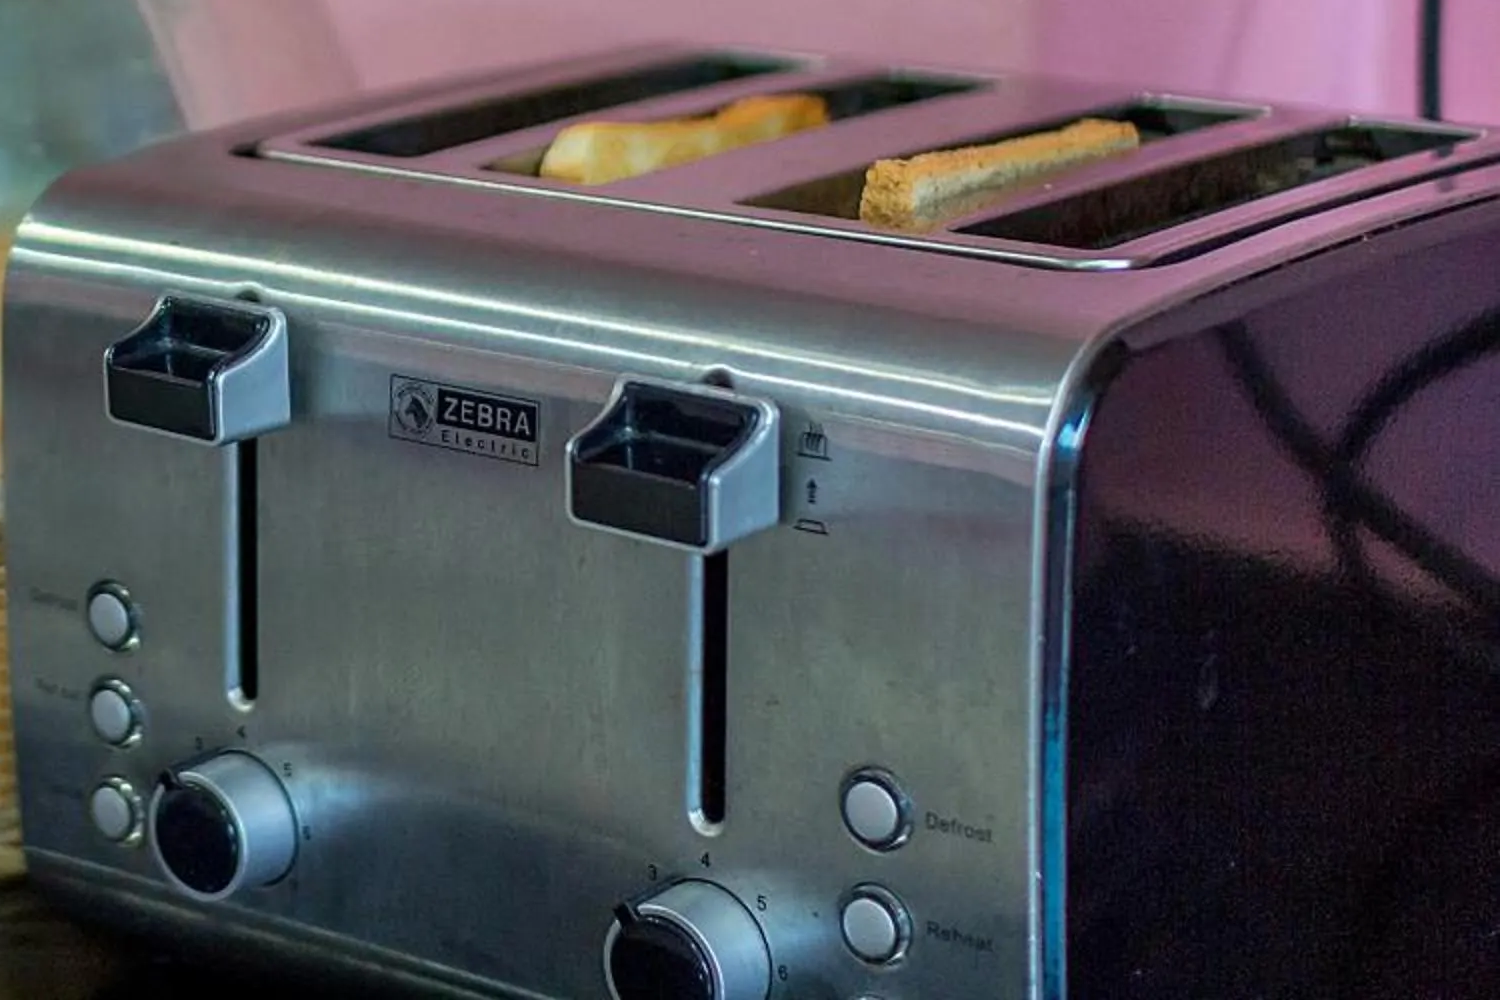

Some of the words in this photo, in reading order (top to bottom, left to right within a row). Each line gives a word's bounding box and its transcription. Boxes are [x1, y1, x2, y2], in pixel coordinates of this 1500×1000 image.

[443, 397, 530, 435] ZEBRA
[441, 430, 529, 459] Electric
[925, 811, 993, 843] Defrost
[700, 852, 711, 868] 4
[756, 895, 767, 911] 5
[778, 965, 788, 981] 6
